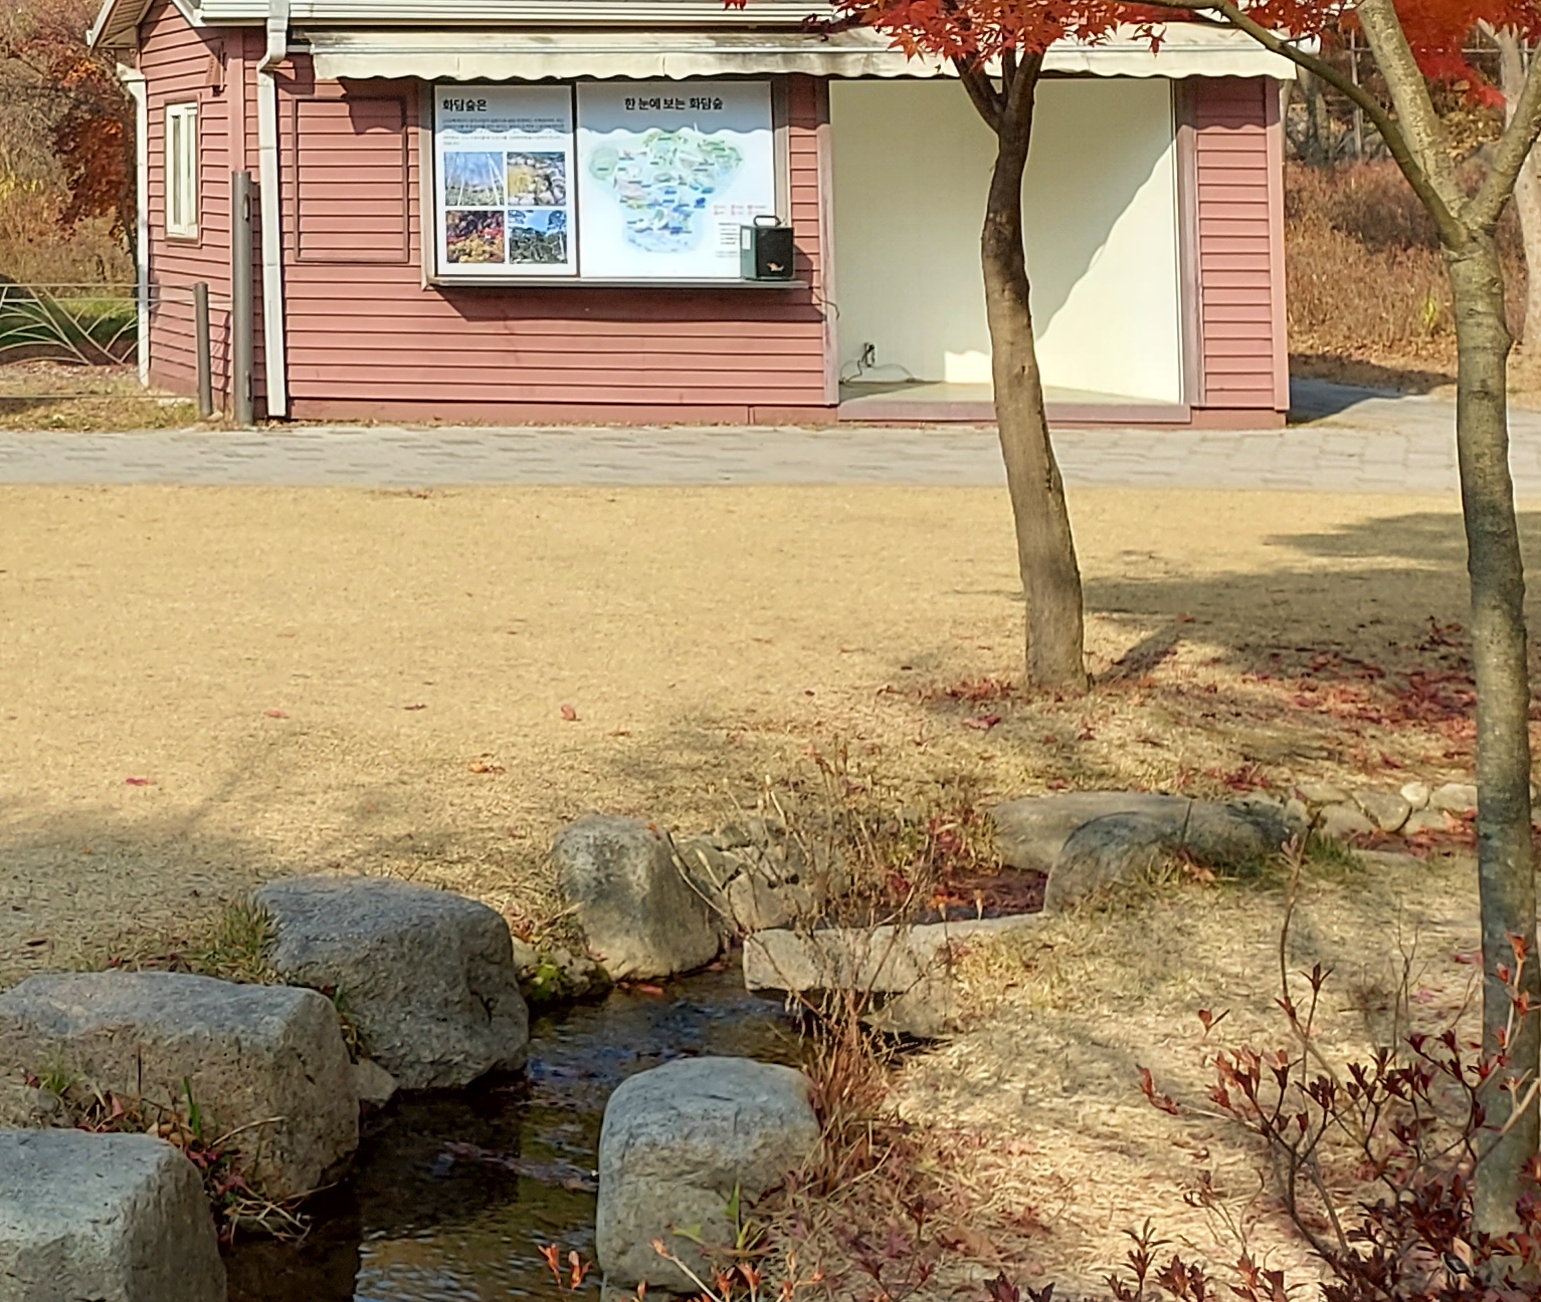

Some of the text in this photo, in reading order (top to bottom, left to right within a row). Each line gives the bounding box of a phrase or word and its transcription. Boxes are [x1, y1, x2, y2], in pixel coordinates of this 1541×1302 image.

[443, 98, 487, 112] 화담숲은
[624, 98, 724, 110] 한 눈에 보는 화담숲
